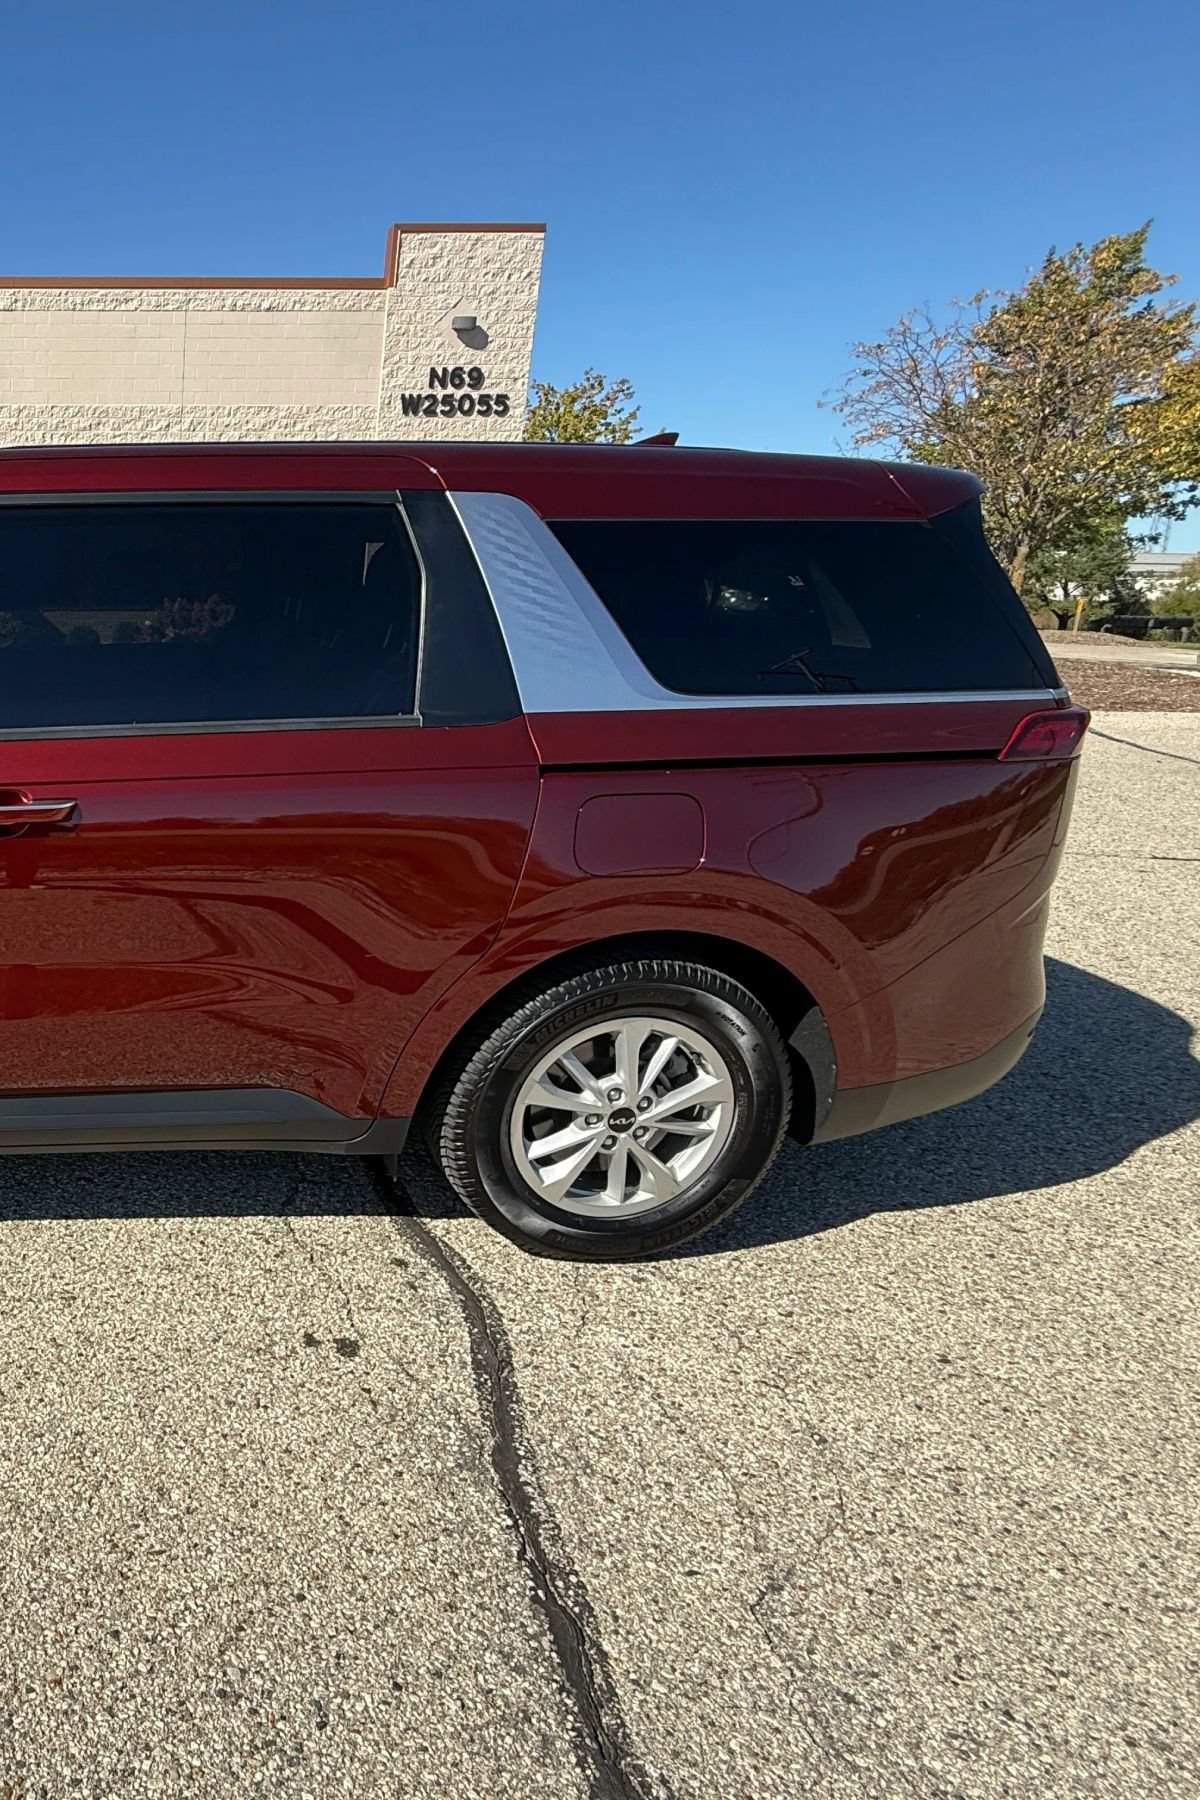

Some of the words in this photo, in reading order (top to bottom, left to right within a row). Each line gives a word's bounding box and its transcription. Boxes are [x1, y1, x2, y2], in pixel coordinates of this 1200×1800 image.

[428, 366, 485, 390] N69
[401, 393, 510, 418] W25055
[535, 994, 616, 1041] MICHELIN
